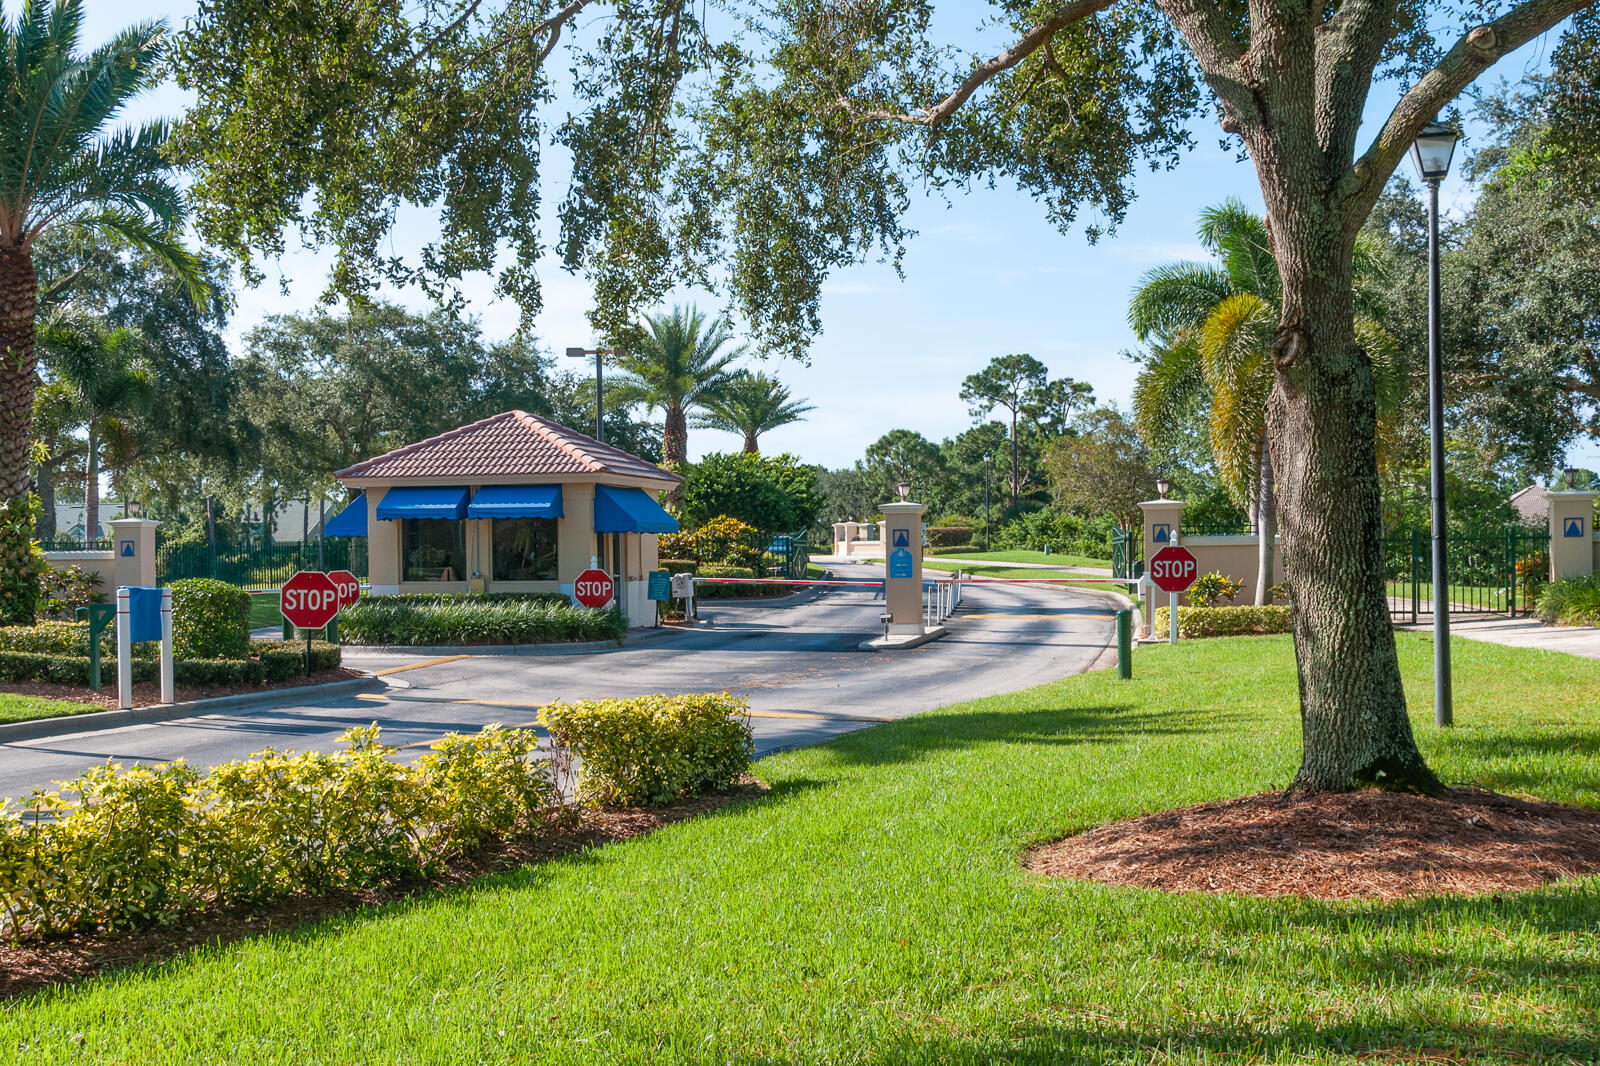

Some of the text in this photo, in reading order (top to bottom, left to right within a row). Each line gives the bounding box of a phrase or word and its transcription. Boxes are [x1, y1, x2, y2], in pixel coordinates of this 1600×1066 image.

[1153, 560, 1195, 578] STOP
[335, 582, 358, 598] OP
[577, 581, 611, 597] STOP
[284, 589, 336, 611] STOP
